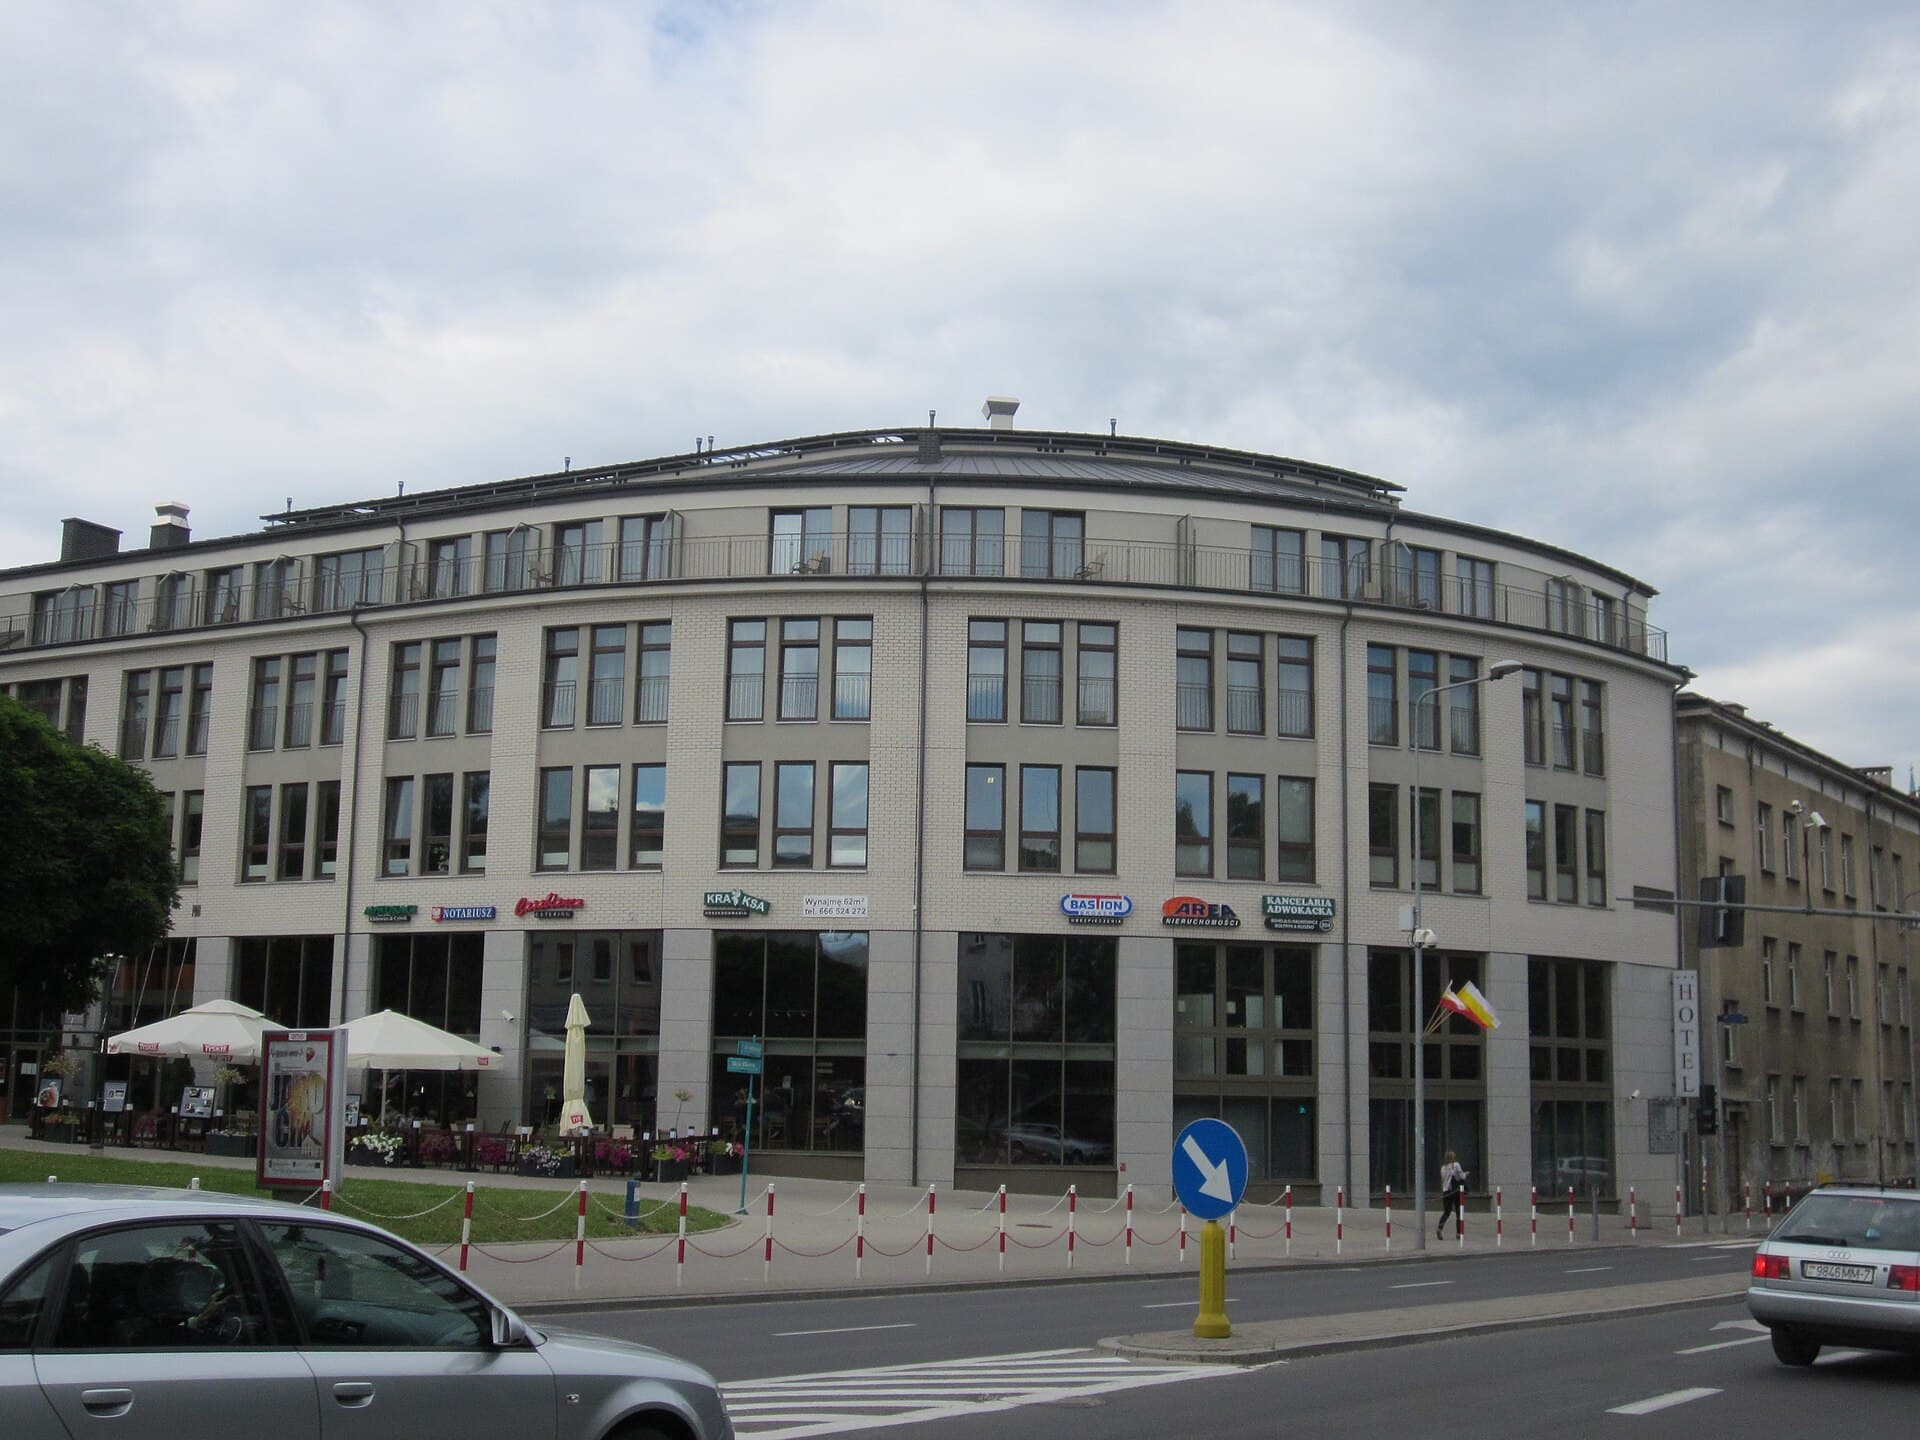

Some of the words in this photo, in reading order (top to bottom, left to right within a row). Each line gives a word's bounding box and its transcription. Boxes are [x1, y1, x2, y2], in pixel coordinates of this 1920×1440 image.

[804, 898, 842, 907] Wynajmę
[1070, 895, 1123, 910] BASTION
[1266, 896, 1332, 907] KANCELARIA
[443, 907, 493, 918] NOTARIUSZ
[1173, 903, 1238, 917] AREA
[1267, 905, 1333, 916] ADWOKACKA
[1165, 918, 1240, 927] NIERUCHOMOŚCI
[1678, 983, 1696, 1093] HOTEL
